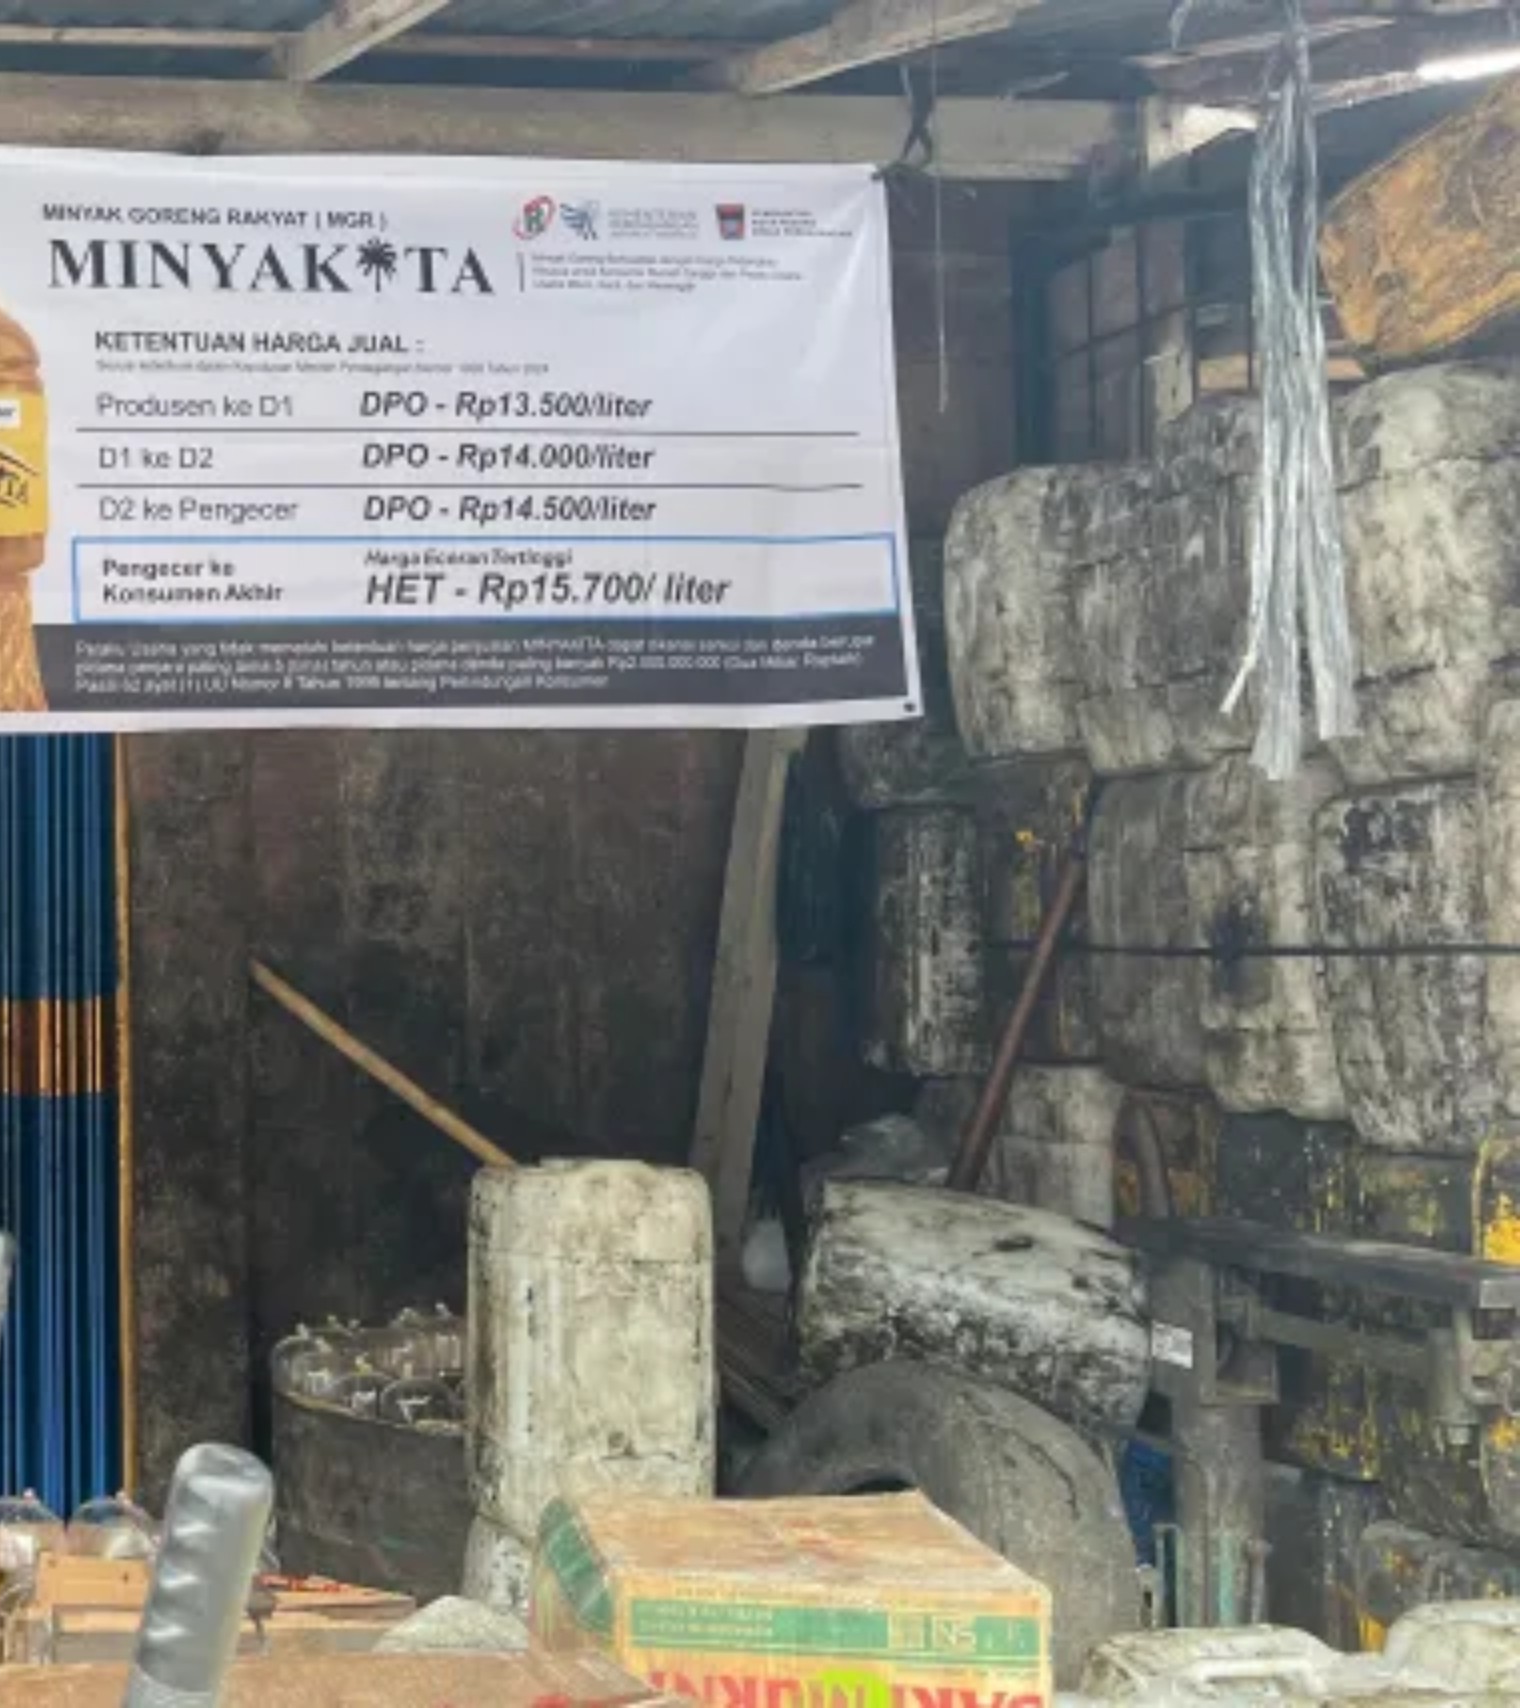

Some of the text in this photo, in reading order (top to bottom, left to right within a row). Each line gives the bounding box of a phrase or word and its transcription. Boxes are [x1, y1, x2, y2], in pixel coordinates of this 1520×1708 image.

[42, 204, 122, 221] MINYAK
[128, 208, 221, 224] GORENG
[227, 209, 308, 226] RAKYAT
[95, 331, 245, 352] KETENTUAN
[253, 332, 341, 352] HARGA
[347, 335, 409, 353] JUAL
[96, 393, 293, 417] Produsen ke D1
[360, 391, 428, 416] DPO
[455, 391, 653, 421] Rp13.500/liter
[99, 447, 213, 469] D1 ke D2
[363, 443, 429, 468] DPO
[456, 443, 655, 472] Rp14.000/liter
[99, 496, 299, 524] D2 ke Pengecer
[364, 495, 432, 521] DPO
[459, 496, 657, 526] Rp14.500/liter
[103, 559, 235, 580] Pengecer ke
[103, 584, 284, 603] Konsumen Akhir
[366, 573, 445, 604] HET
[479, 572, 656, 610] Rp15.700/
[663, 573, 732, 604] liter
